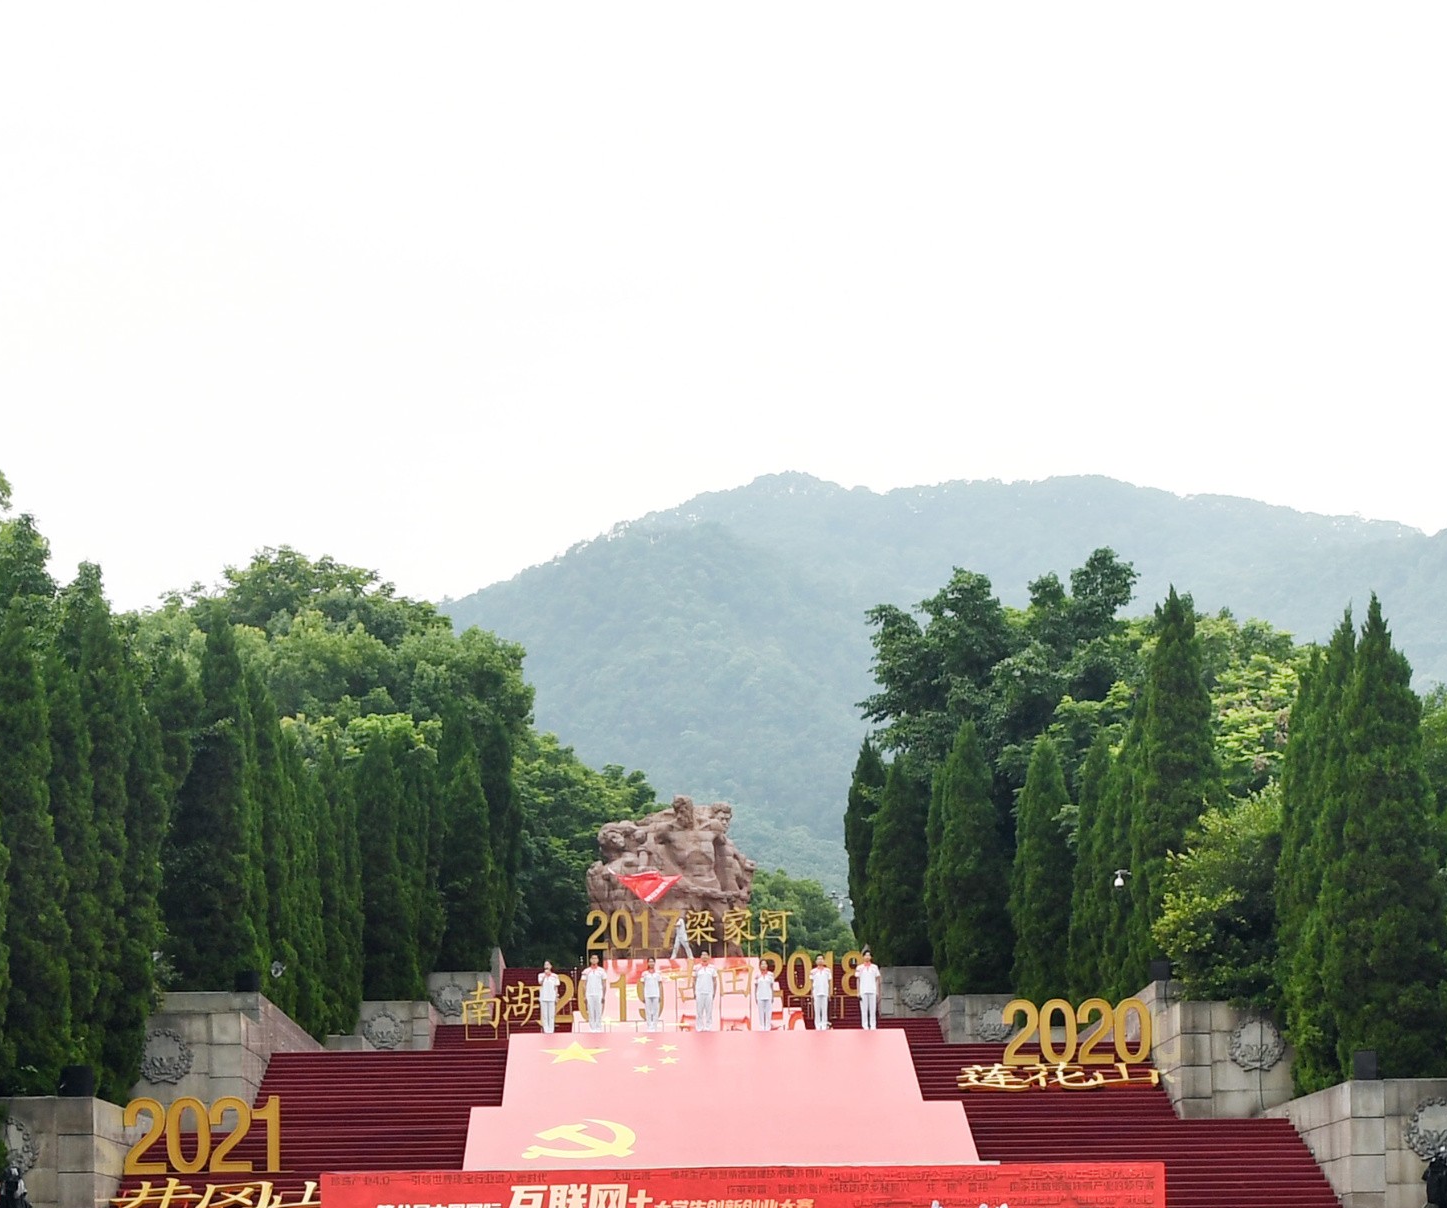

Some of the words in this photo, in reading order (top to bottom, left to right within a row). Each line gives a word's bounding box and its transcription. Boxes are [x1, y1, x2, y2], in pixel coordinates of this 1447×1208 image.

[586, 908, 677, 951] 2017
[685, 907, 793, 946] 梁家河
[461, 979, 543, 1029] 南湖
[1002, 997, 1152, 1065] 2020
[956, 1061, 1160, 1093] 莲花山
[123, 1095, 281, 1175] 2021
